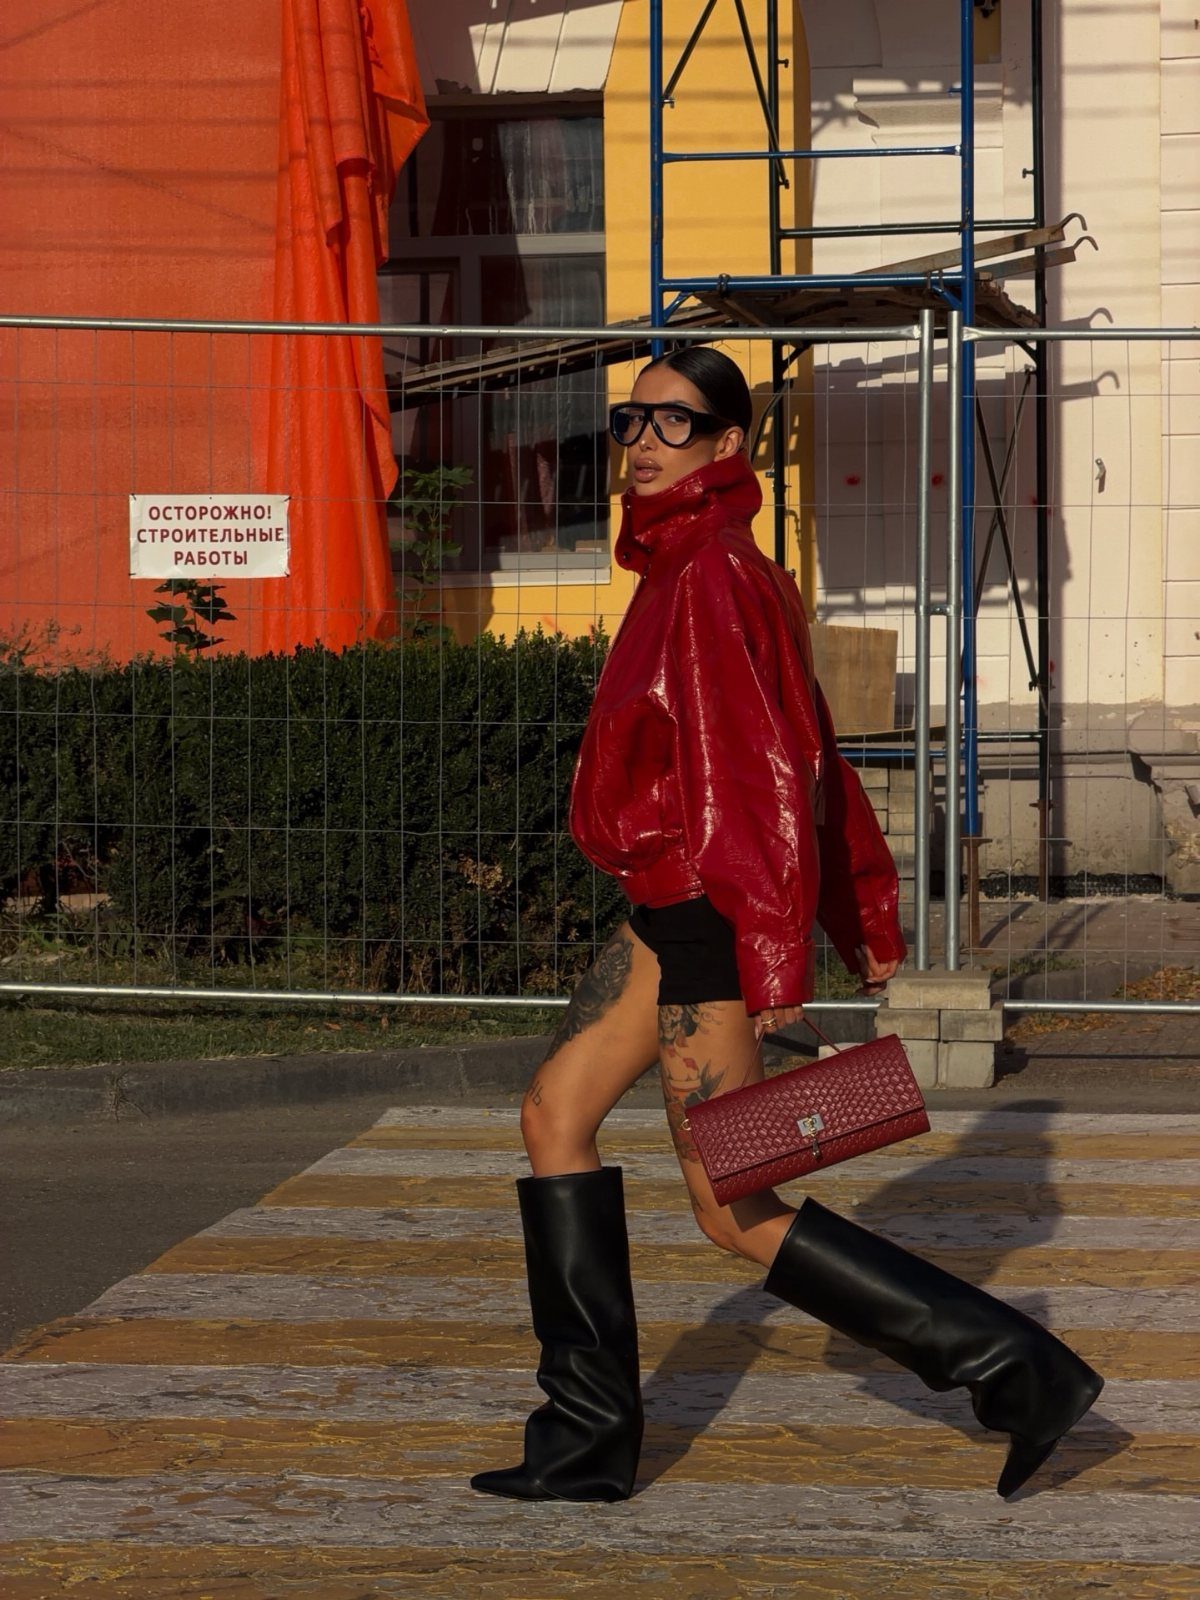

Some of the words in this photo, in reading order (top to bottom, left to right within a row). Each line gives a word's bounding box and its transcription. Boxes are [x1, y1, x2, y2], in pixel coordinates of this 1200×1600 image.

[148, 505, 272, 521] ОСТОРОЖНО!
[136, 527, 285, 543] СТРОИТЕЛЬНЫЕ
[174, 550, 248, 566] РАБОТЫ
